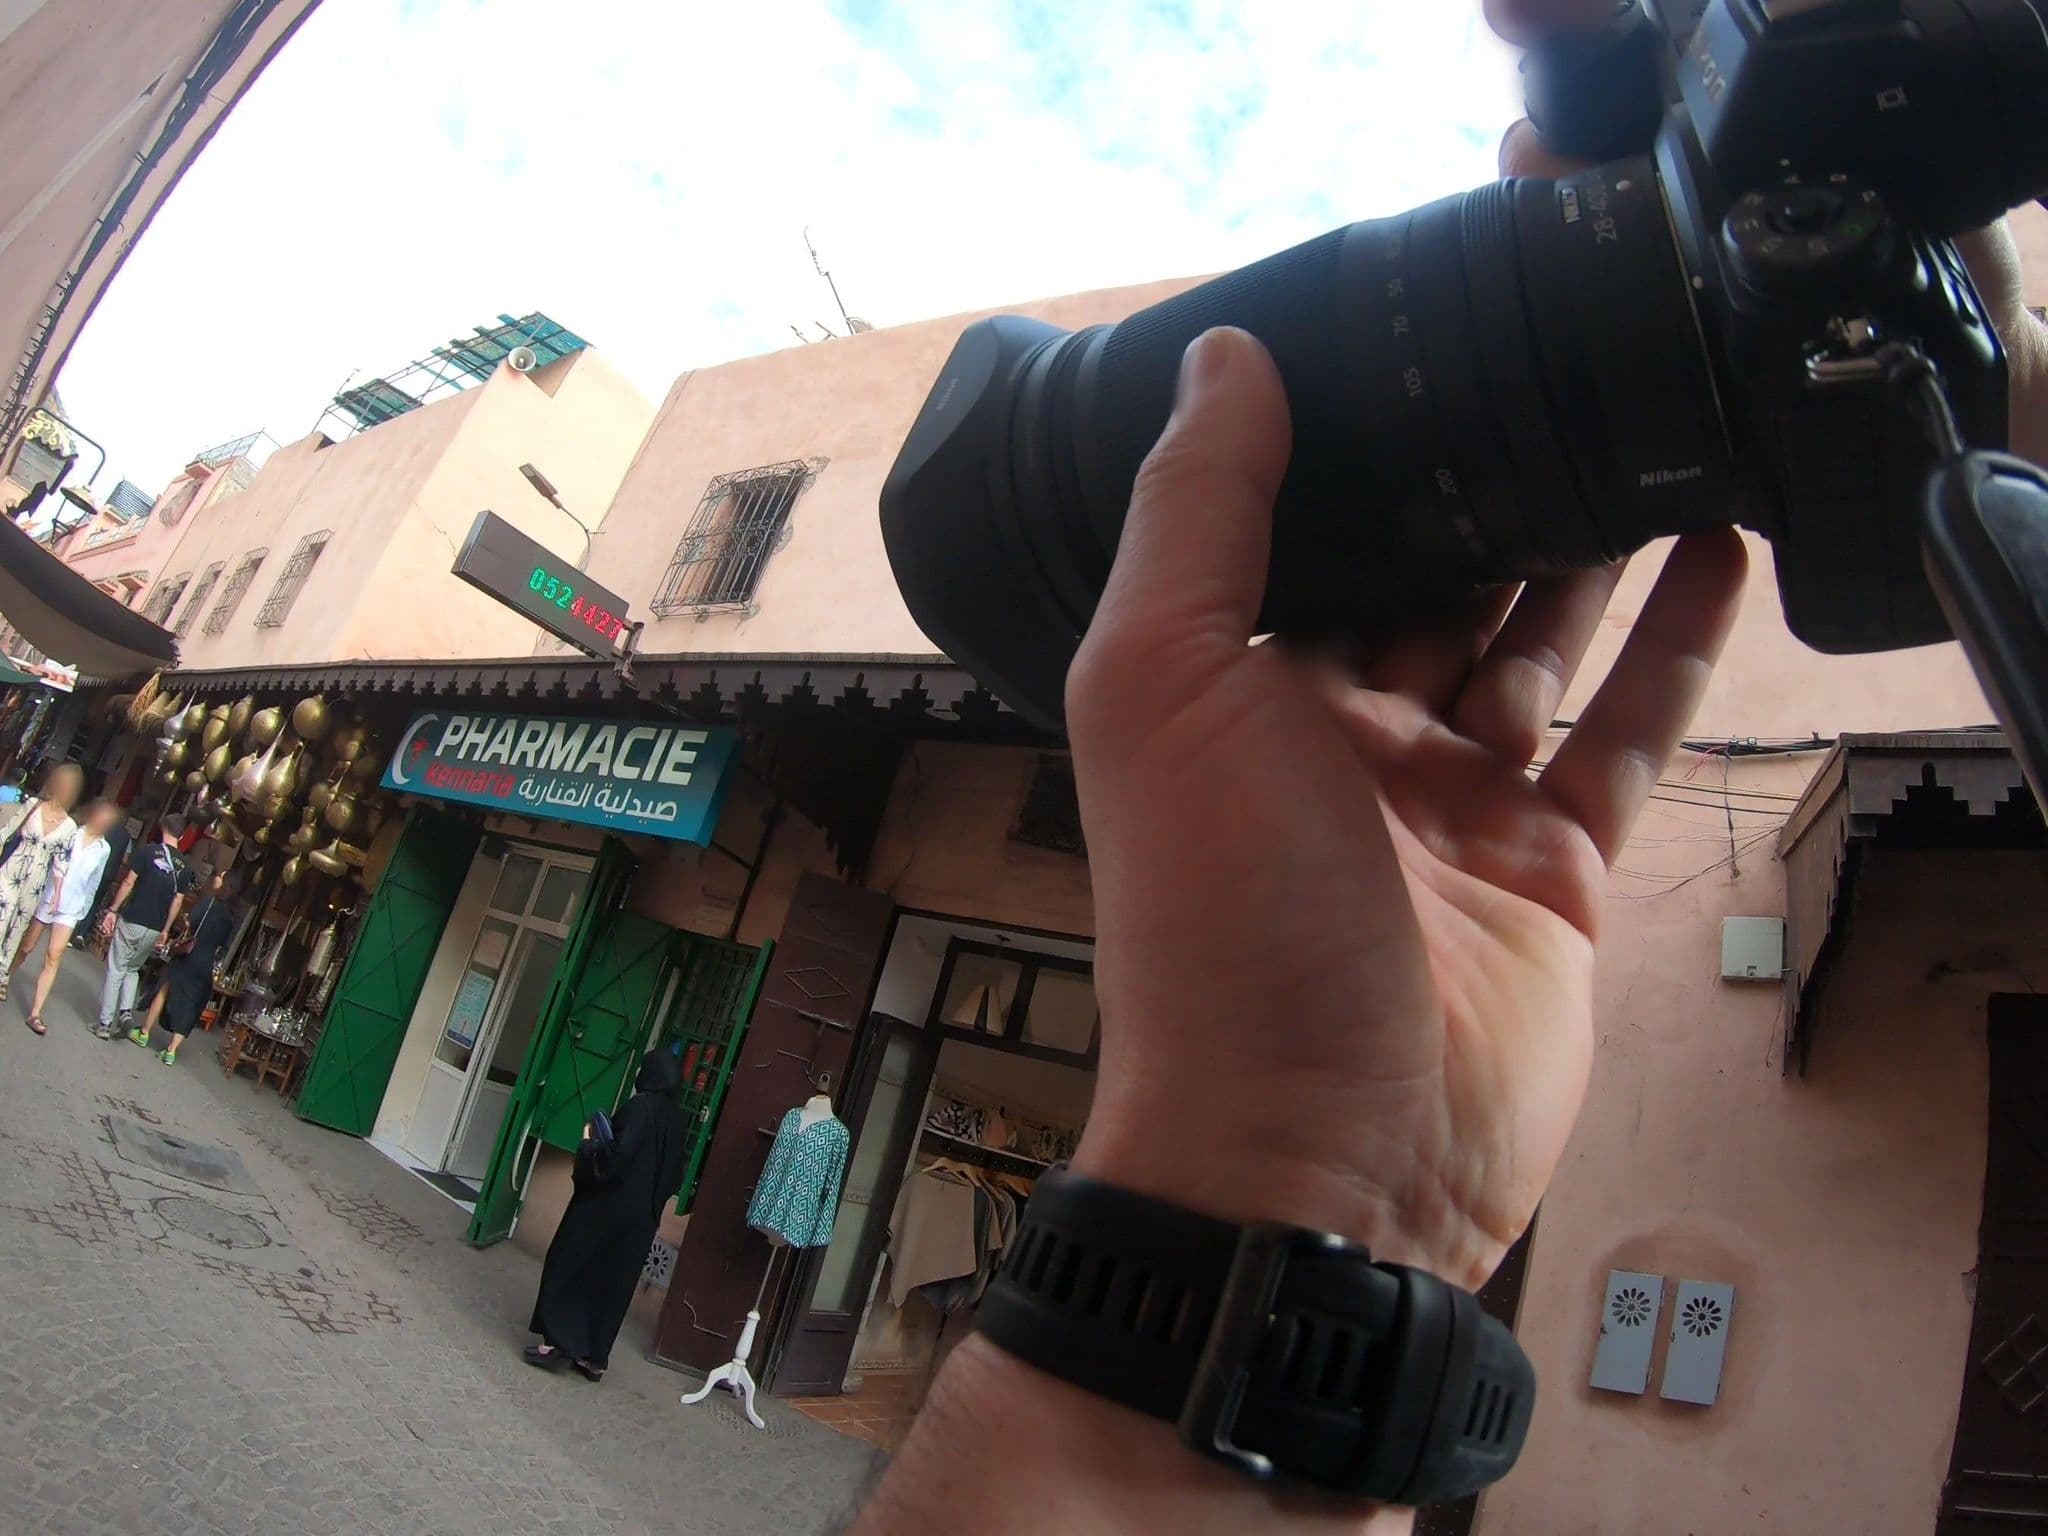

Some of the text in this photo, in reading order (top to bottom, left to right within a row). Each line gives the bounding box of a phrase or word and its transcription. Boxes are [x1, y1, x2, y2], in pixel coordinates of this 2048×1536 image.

[1403, 367, 1423, 398] 105
[1639, 465, 1703, 488] Nikon
[434, 715, 709, 786] PHARMACIE
[518, 773, 678, 825] صيدلية القنارية
